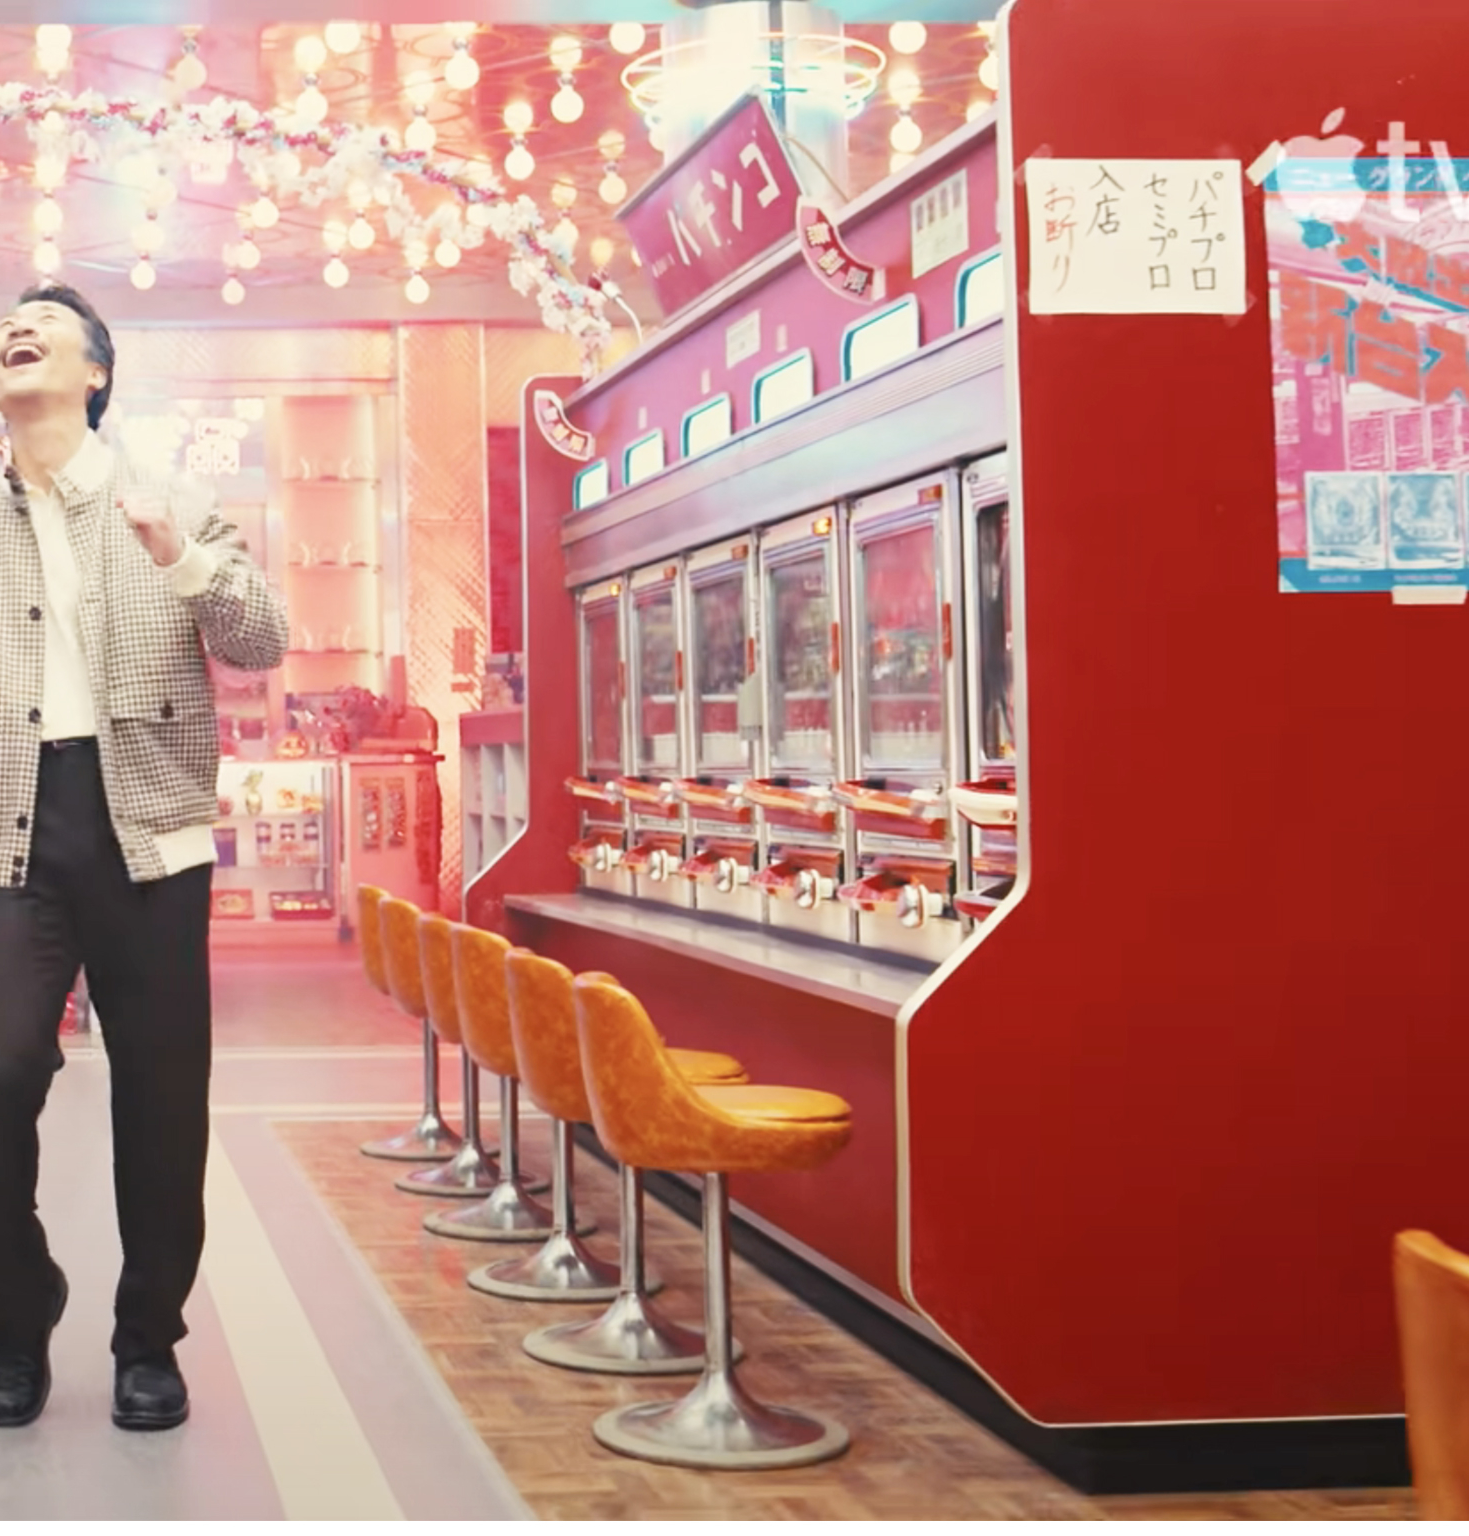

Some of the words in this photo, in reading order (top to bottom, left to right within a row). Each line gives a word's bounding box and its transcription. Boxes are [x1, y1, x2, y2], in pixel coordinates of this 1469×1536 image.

[1044, 183, 1078, 294] お断り
[1086, 165, 1125, 237] 入店
[1144, 173, 1177, 291] セミプロ
[1187, 171, 1225, 291] パチプロ
